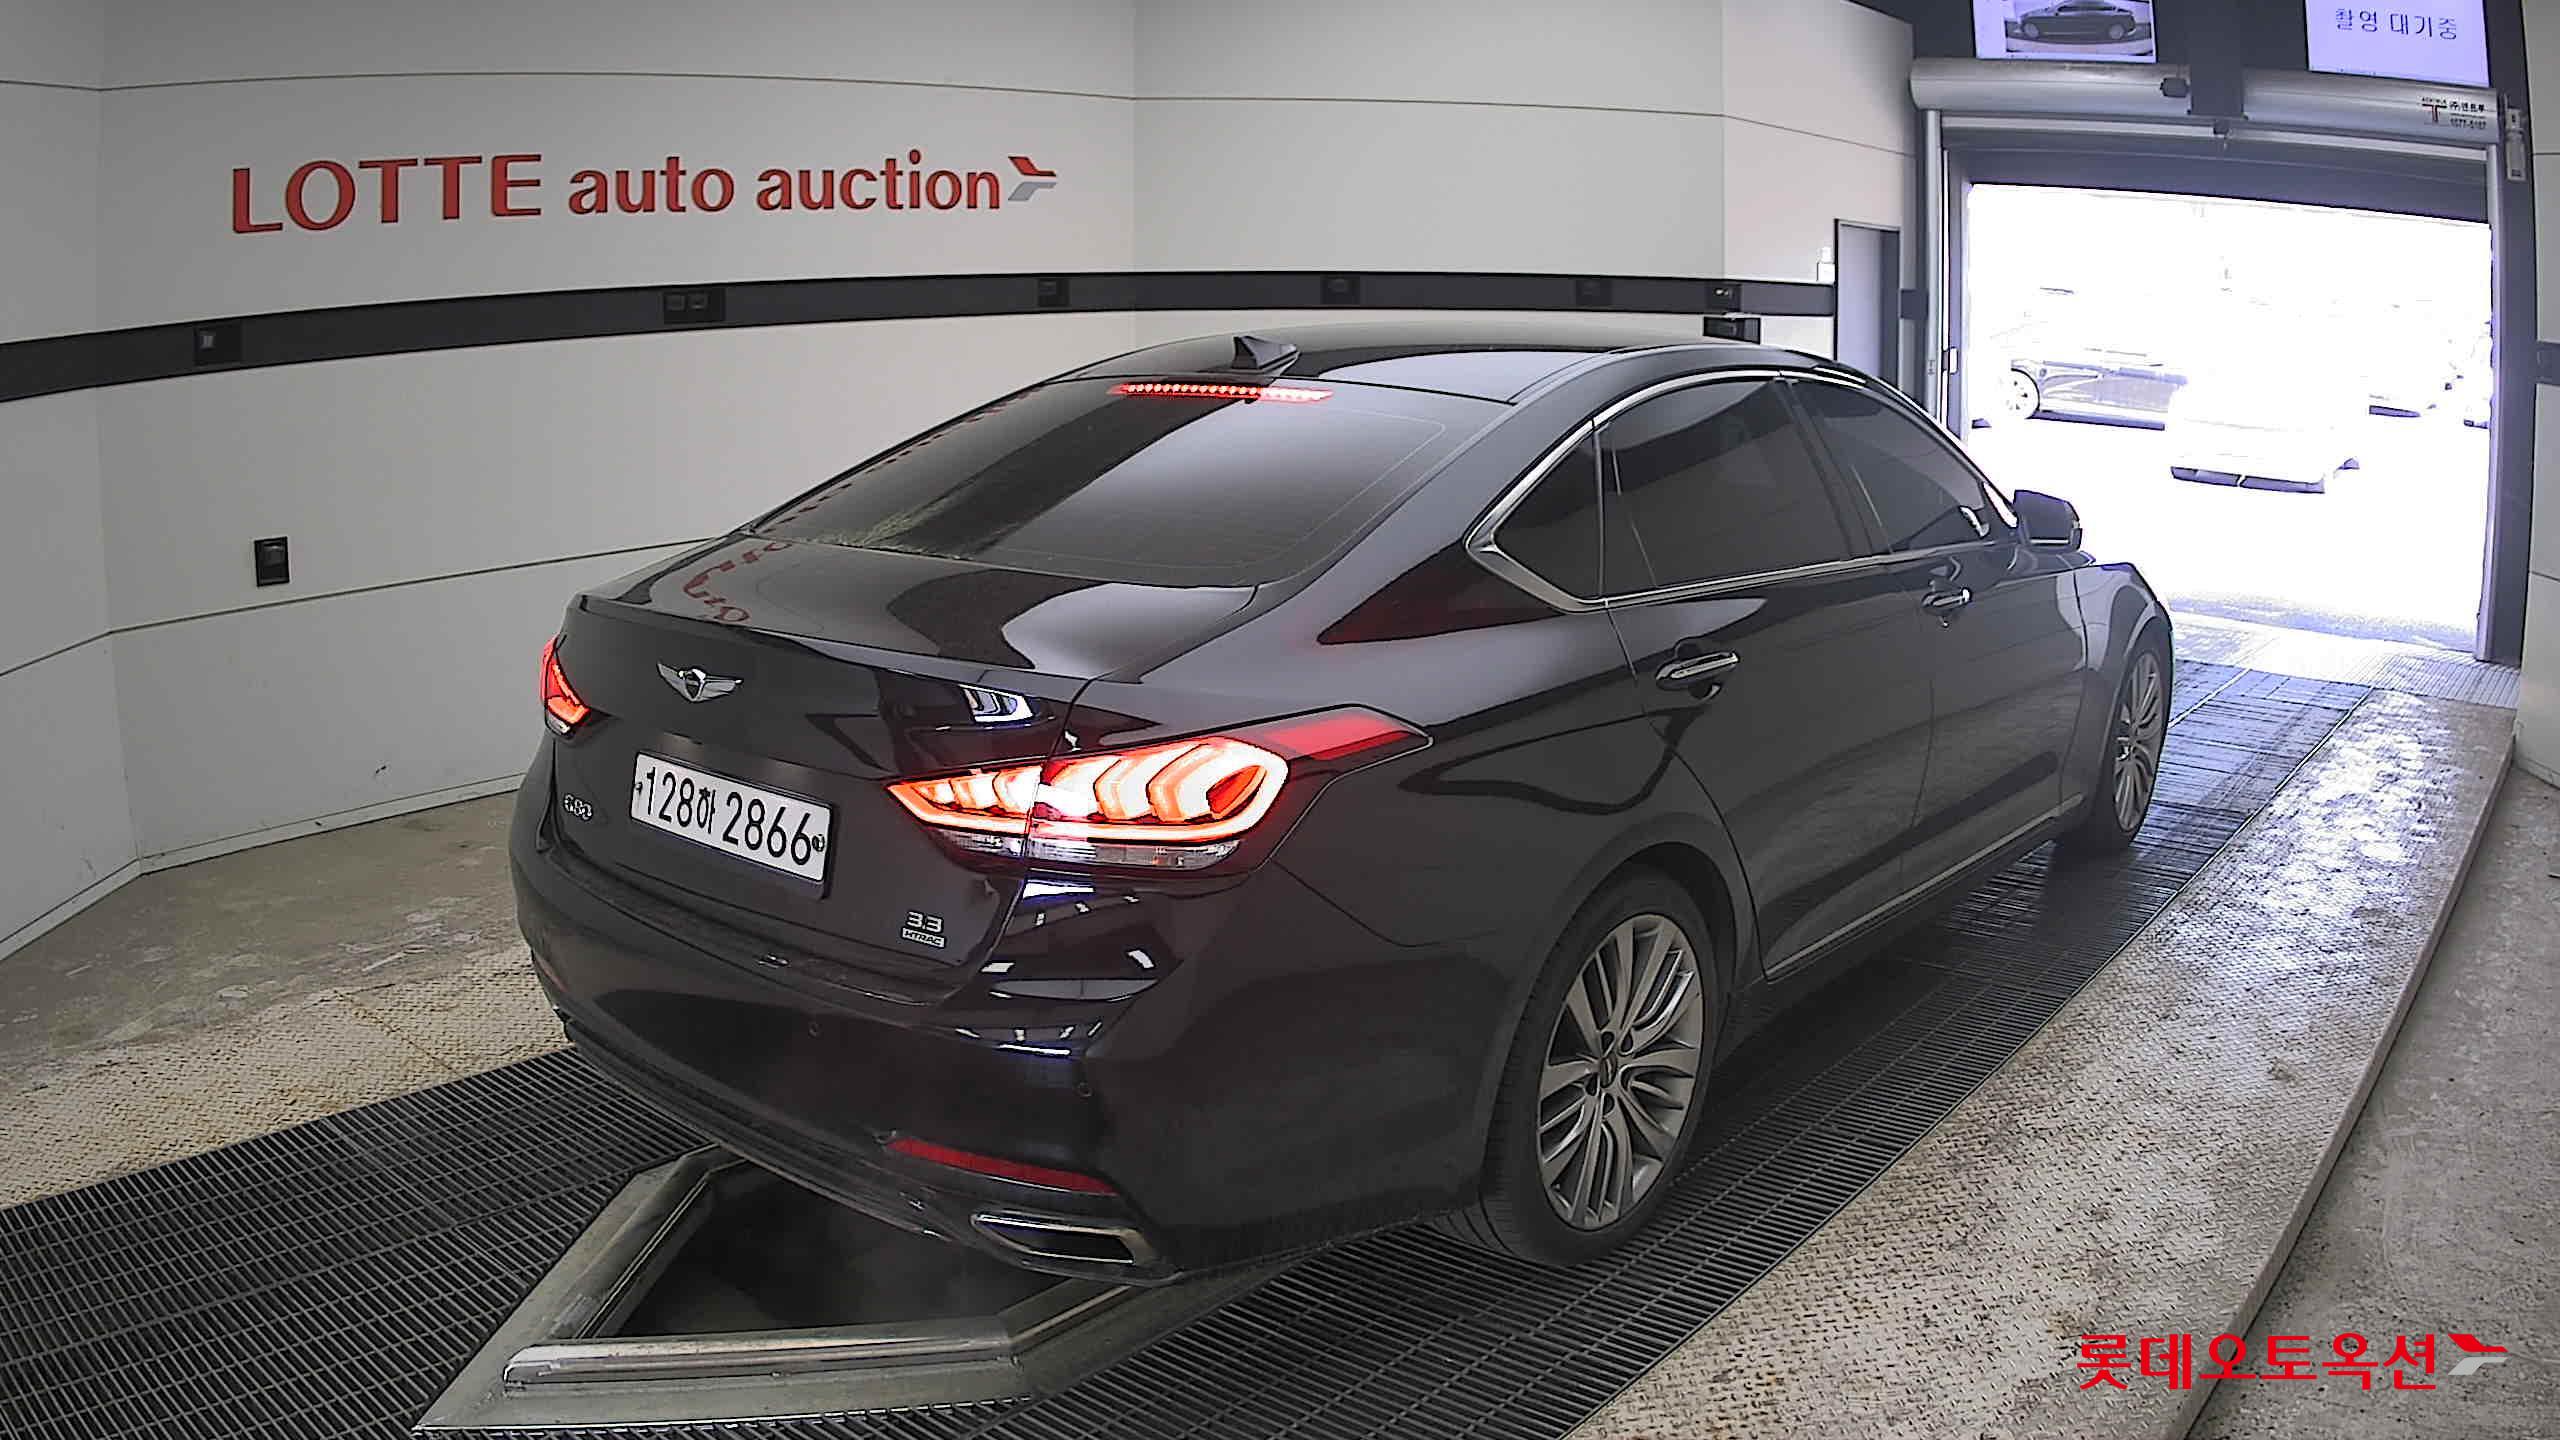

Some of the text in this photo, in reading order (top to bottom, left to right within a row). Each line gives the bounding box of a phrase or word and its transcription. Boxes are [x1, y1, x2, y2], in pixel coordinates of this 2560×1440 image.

[2390, 13, 2457, 40] 대기중
[232, 149, 1000, 234] LOTTE auto auction
[907, 911, 942, 933] 3.3
